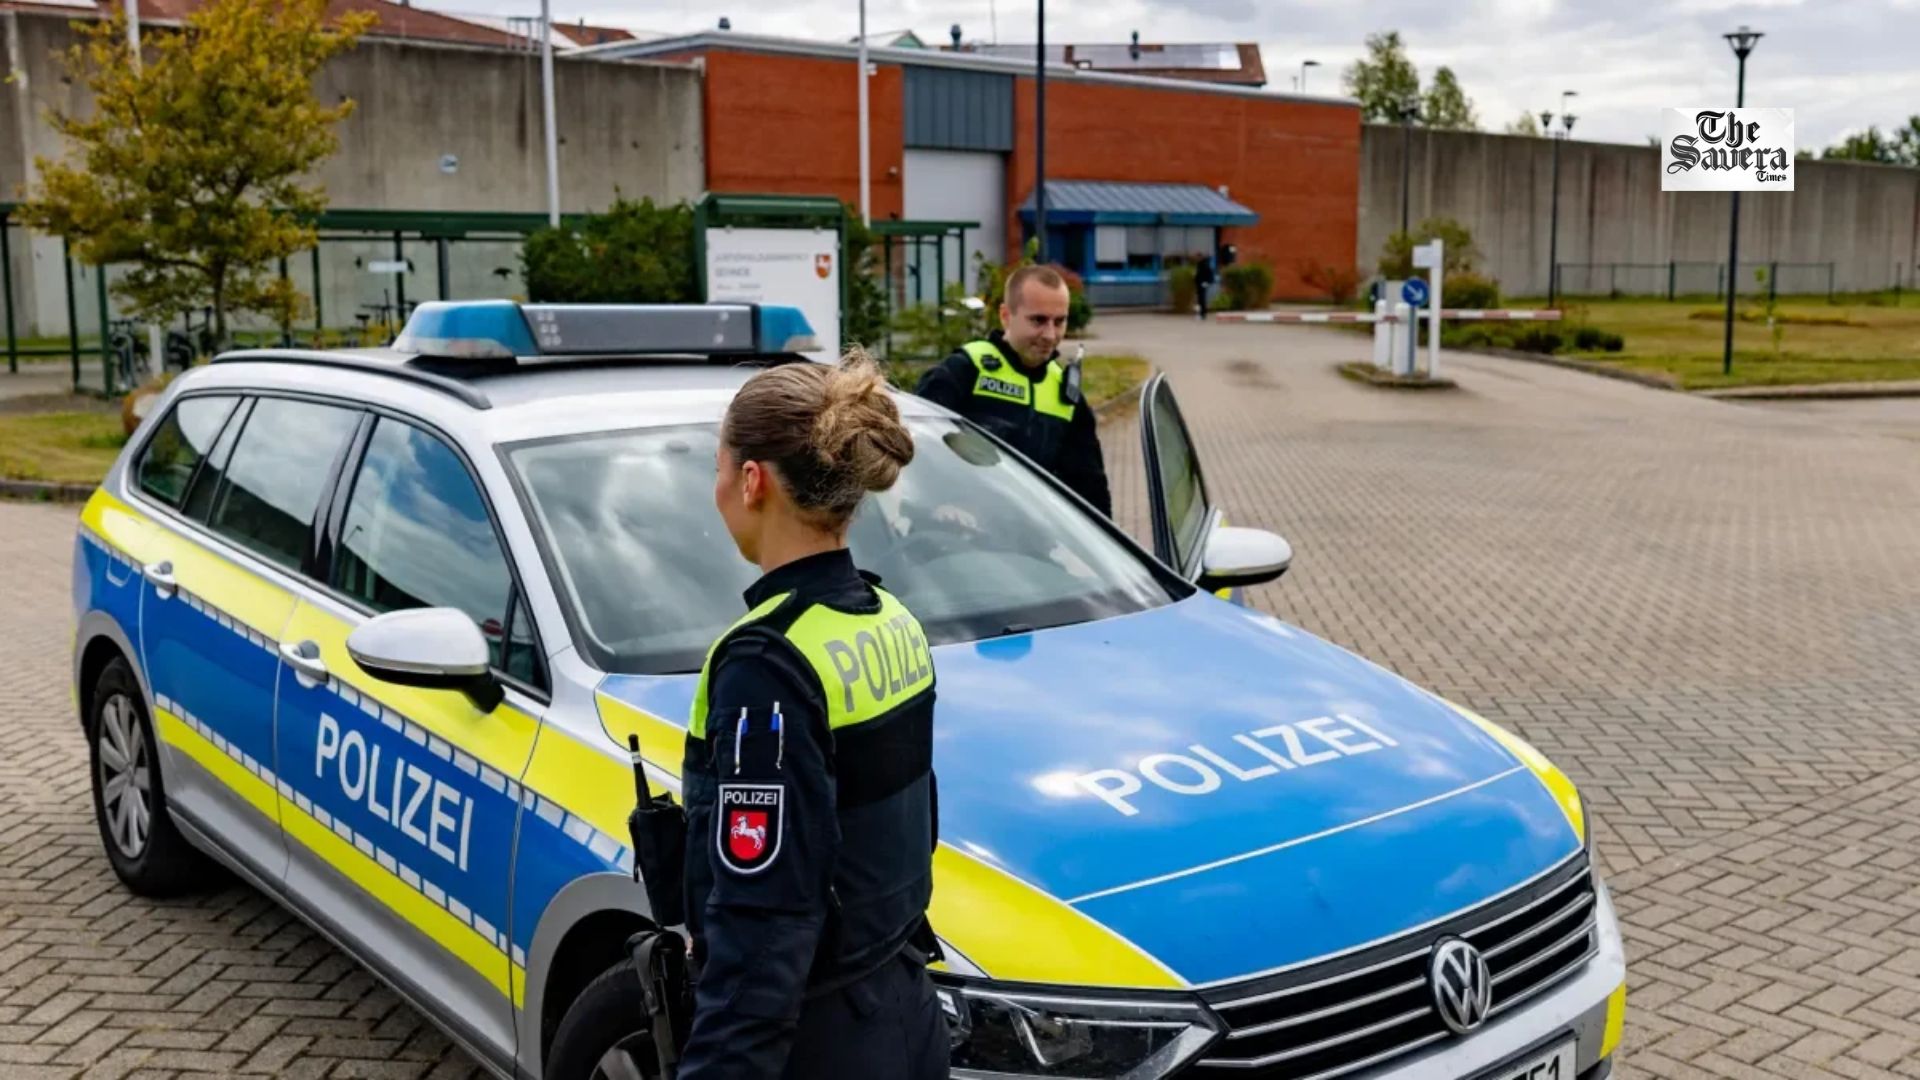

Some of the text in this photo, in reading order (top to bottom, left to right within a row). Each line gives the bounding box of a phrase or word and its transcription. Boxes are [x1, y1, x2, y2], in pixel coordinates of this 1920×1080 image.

[980, 377, 1025, 396] POLIZEI
[315, 711, 474, 872] POLIZEI
[1073, 713, 1399, 816] POLIZEI
[723, 790, 777, 806] POLIZEI
